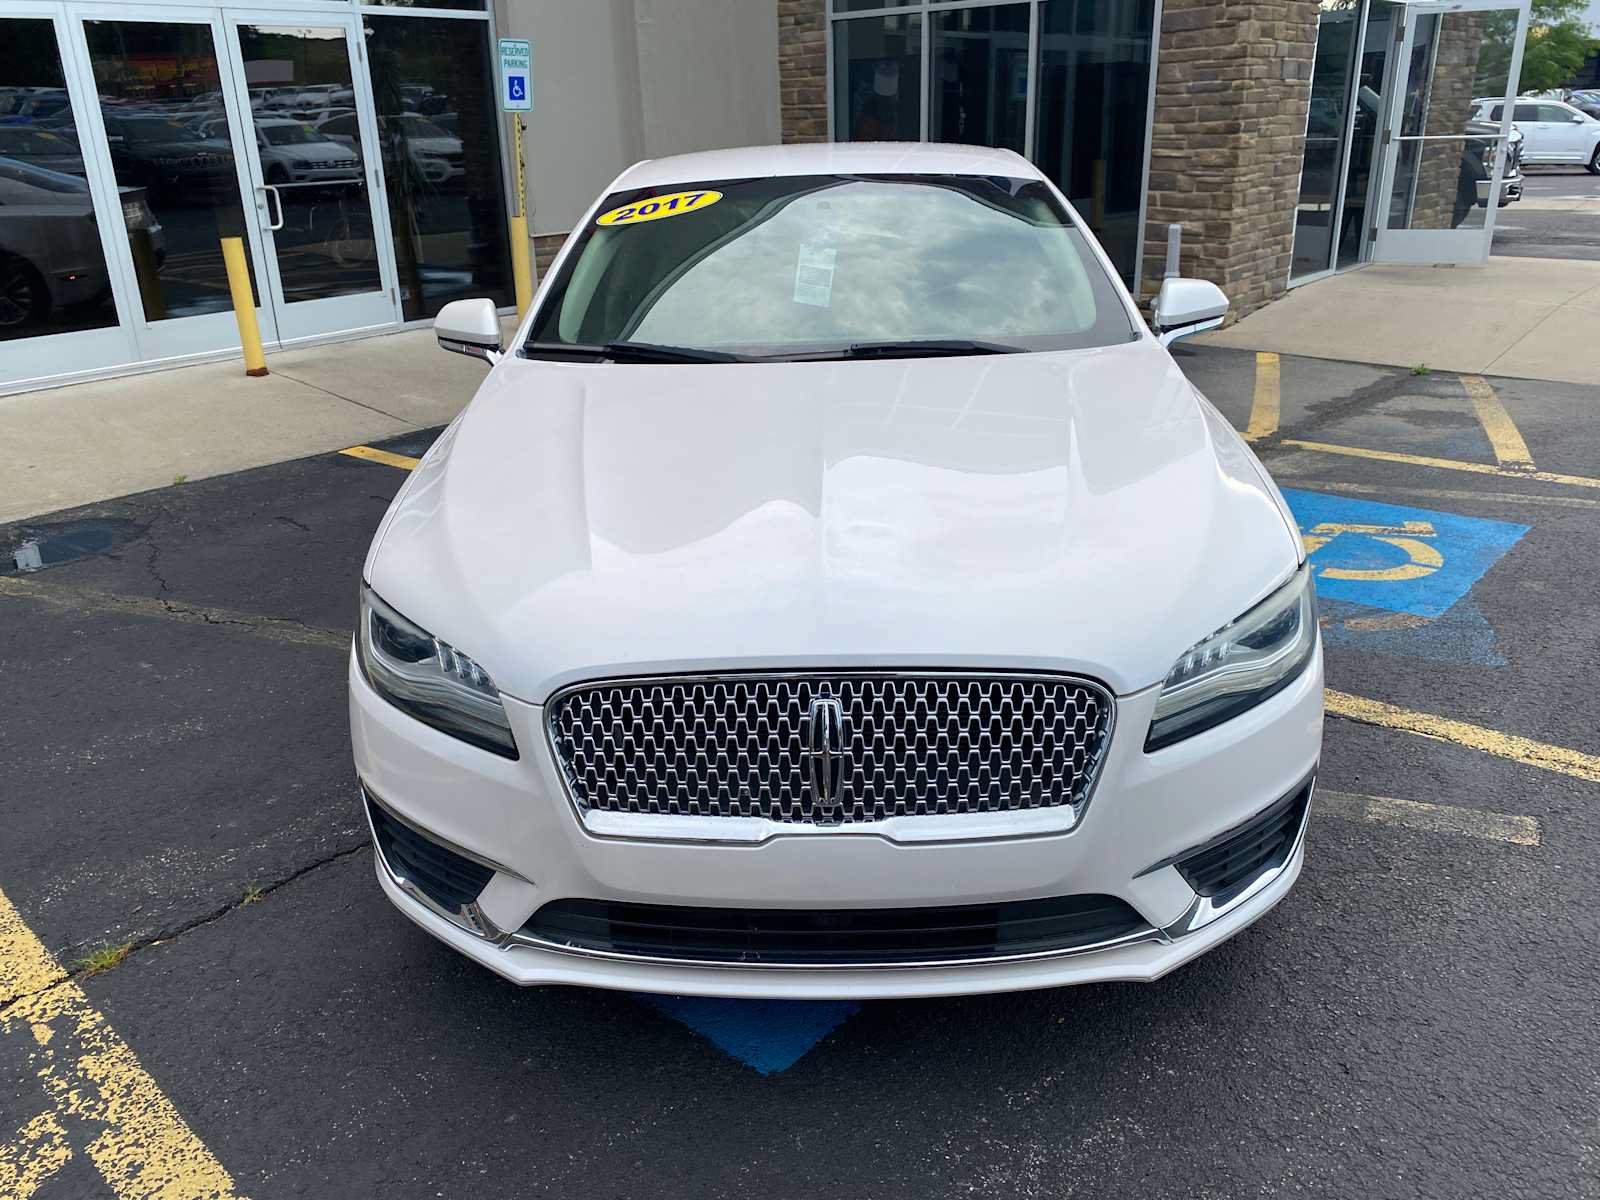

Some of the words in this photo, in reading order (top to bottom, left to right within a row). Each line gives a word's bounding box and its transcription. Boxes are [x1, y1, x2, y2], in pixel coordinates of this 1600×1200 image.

[501, 47, 528, 57] RESERVED
[503, 59, 528, 69] PARKING
[612, 193, 706, 222] 2017
